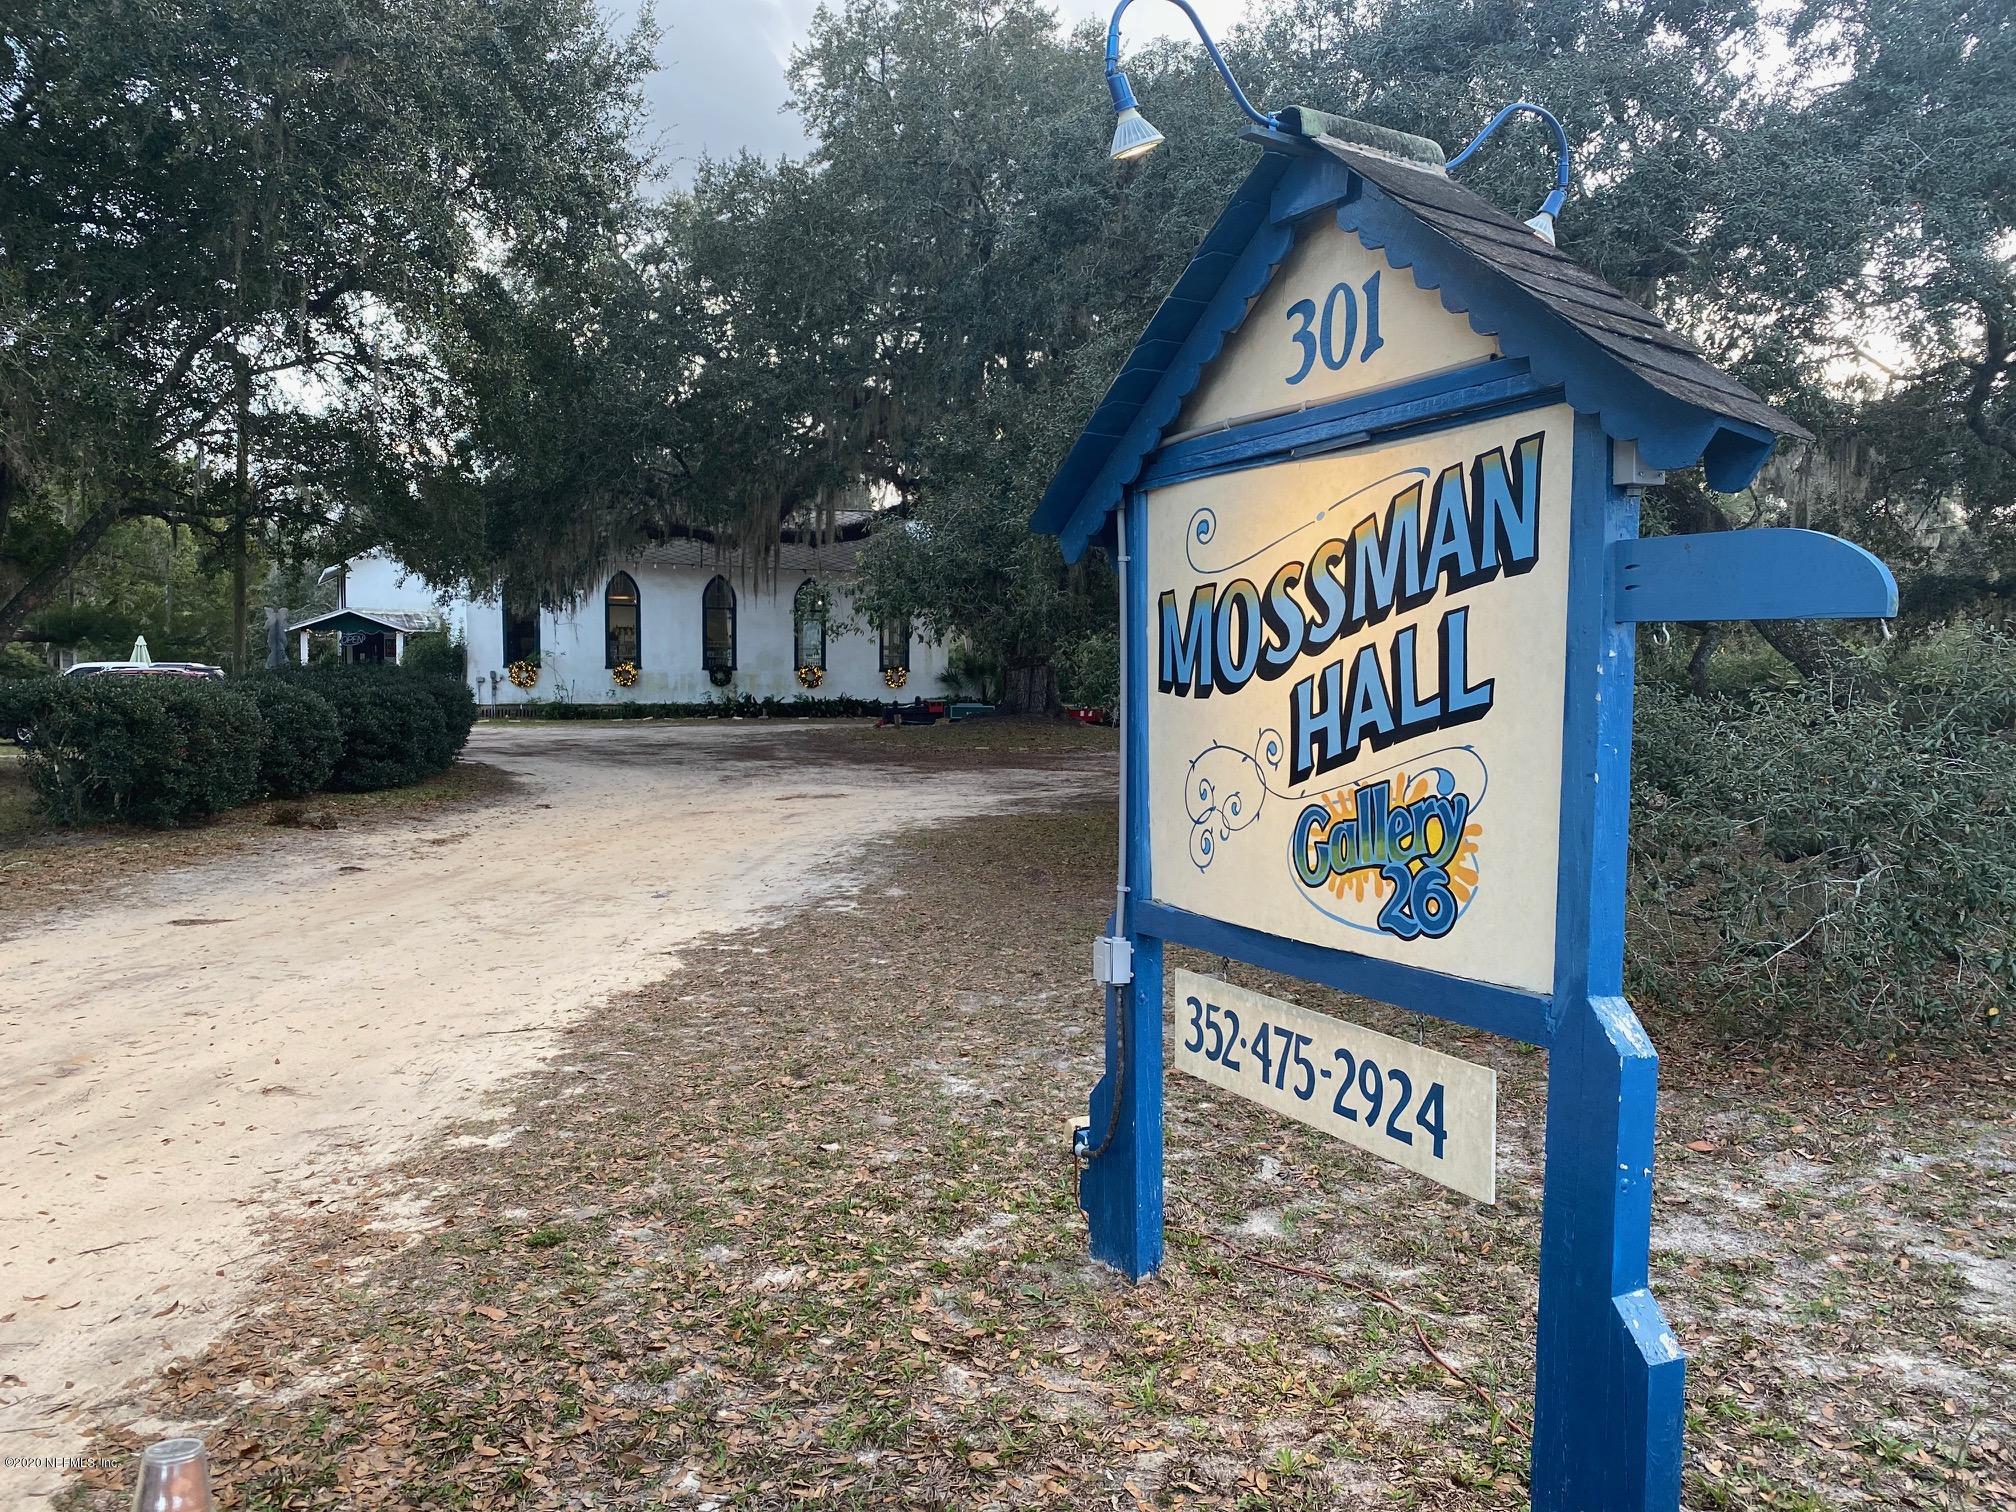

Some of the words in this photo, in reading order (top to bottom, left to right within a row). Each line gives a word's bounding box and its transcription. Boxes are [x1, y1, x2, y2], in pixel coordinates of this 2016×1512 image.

[1285, 270, 1384, 385] 301
[1158, 431, 1545, 699] MOSSMAN
[340, 634, 364, 645] OPEN
[1289, 605, 1495, 787] HALL
[1293, 780, 1469, 888] Gallery
[1377, 863, 1458, 941] 26
